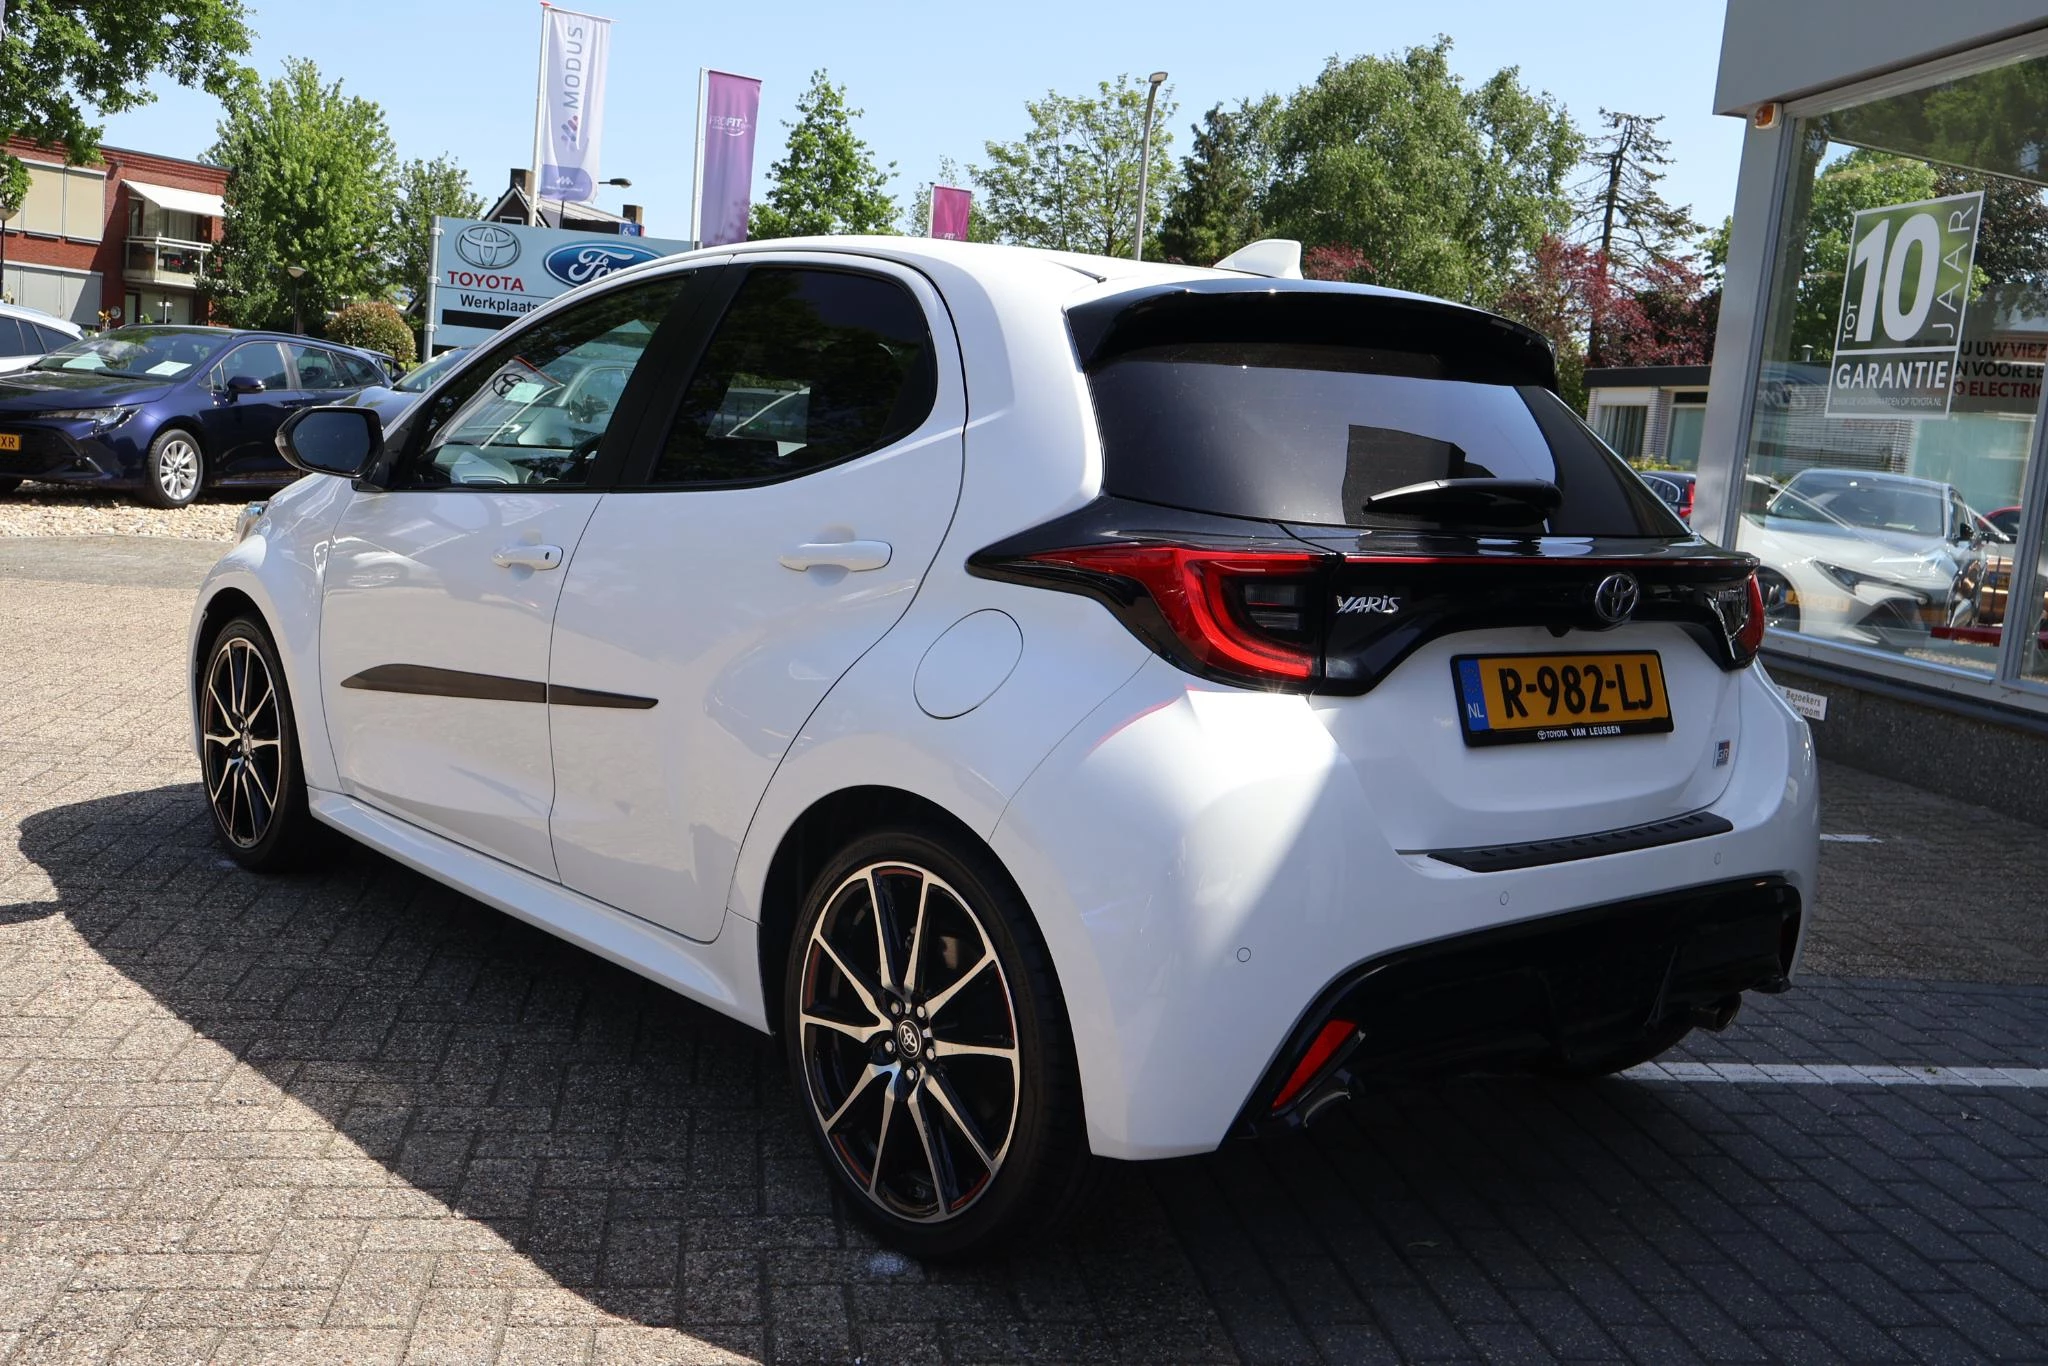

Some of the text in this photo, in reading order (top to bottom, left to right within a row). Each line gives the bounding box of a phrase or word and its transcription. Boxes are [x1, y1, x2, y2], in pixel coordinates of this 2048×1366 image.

[563, 25, 584, 110] MODUS
[566, 247, 635, 282] Fo
[1932, 204, 1974, 339] JAAR
[448, 271, 525, 292] TOYOTA
[1853, 212, 1940, 342] 10
[460, 294, 539, 314] Werkplaats
[1842, 301, 1857, 343] TOT
[1977, 341, 2006, 358] UW
[1836, 361, 1948, 389] GARANTIE
[1972, 362, 2022, 379] VOOR
[1498, 663, 1653, 719] R-982-LJ
[1785, 689, 1821, 707] Bezoekers
[1467, 702, 1485, 719] NL
[1546, 725, 1621, 738] TOYOTA VAN LEUSSEN
